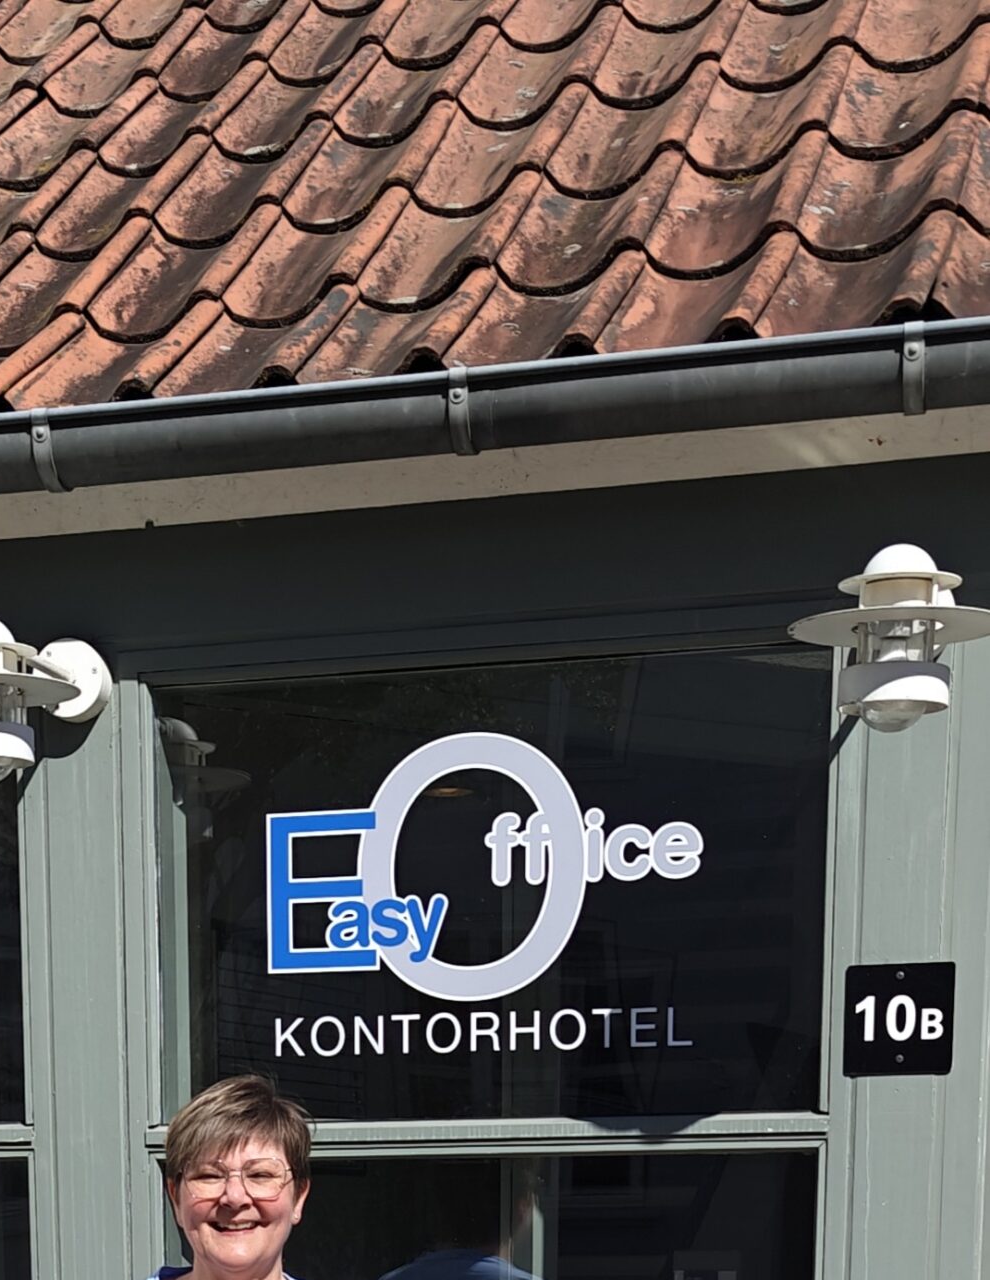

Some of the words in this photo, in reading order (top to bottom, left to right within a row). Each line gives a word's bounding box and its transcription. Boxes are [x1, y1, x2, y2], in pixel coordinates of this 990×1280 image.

[266, 809, 449, 974] Easy
[357, 731, 704, 1002] Office
[274, 1006, 694, 1058] KONTORHOTEL
[854, 994, 944, 1042] 10B
